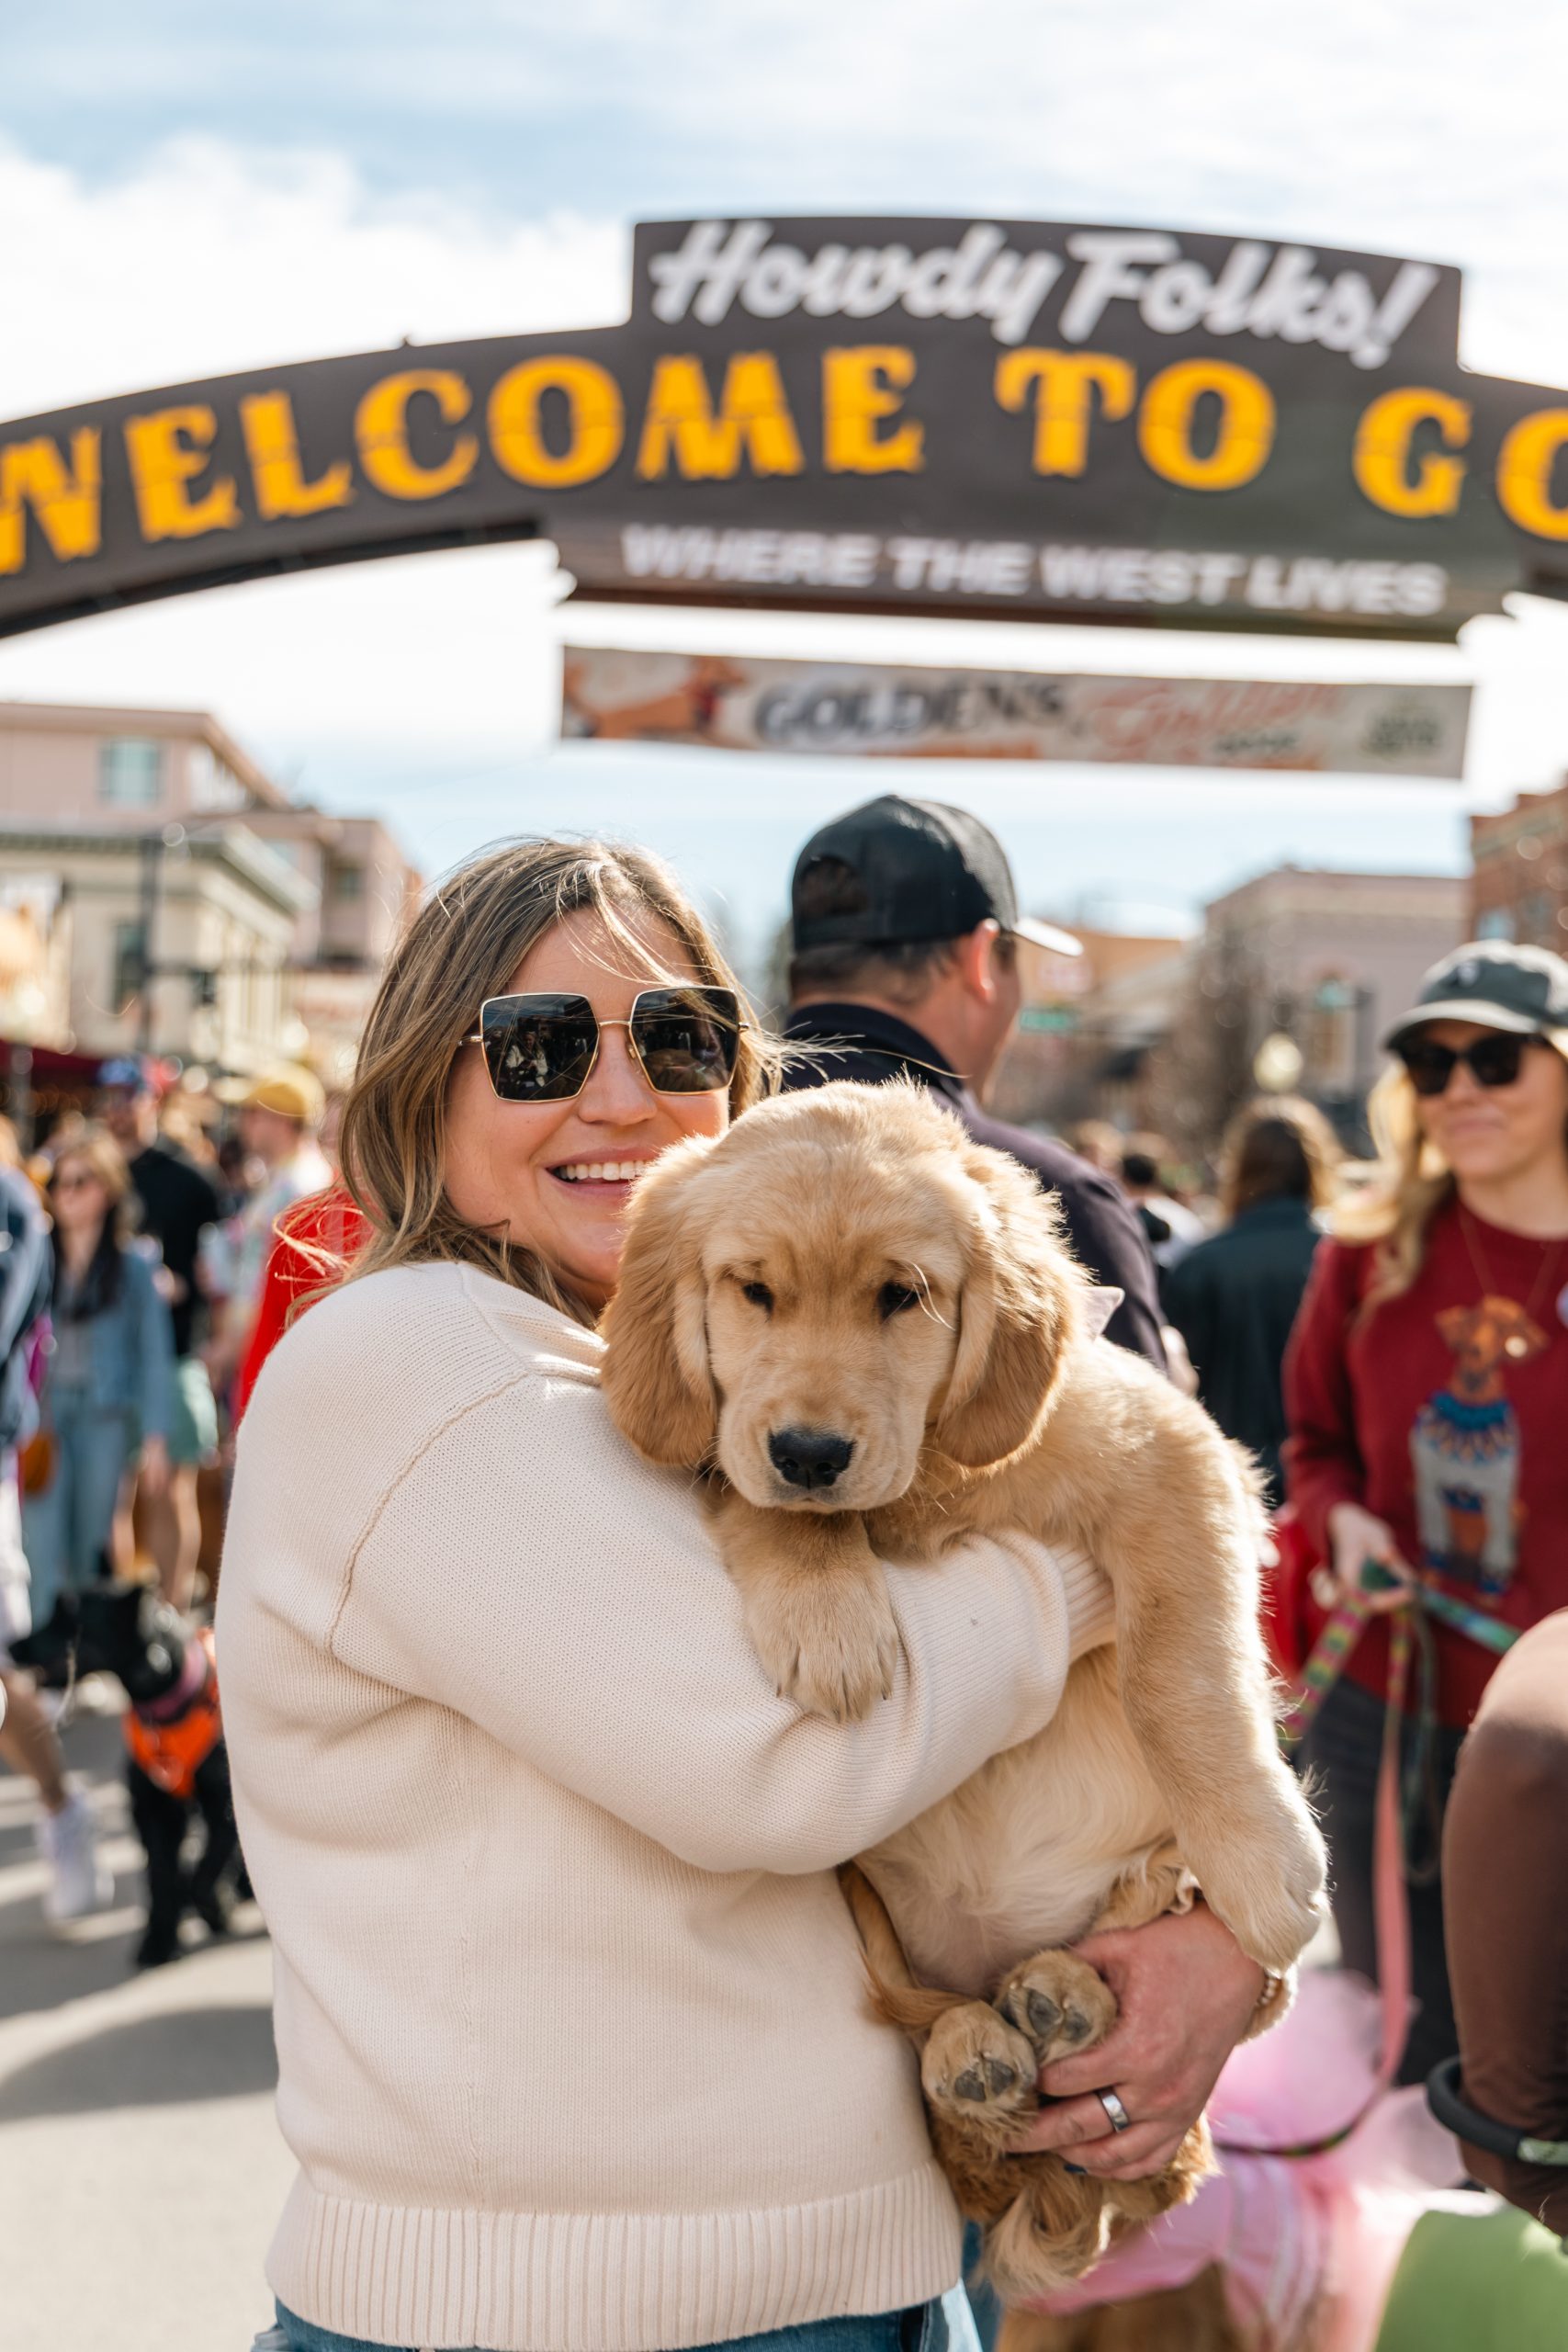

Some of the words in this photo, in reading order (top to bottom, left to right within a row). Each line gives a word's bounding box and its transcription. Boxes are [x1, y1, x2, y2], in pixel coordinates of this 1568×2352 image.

[648, 220, 1063, 345] Howdy
[1058, 232, 1439, 369] Folks!
[0, 344, 924, 574] WELCOME
[994, 346, 1277, 491] TO
[622, 523, 877, 588] WHERE
[885, 537, 1032, 595] THE
[1039, 544, 1247, 606] WEST
[1245, 556, 1449, 616] LIVES
